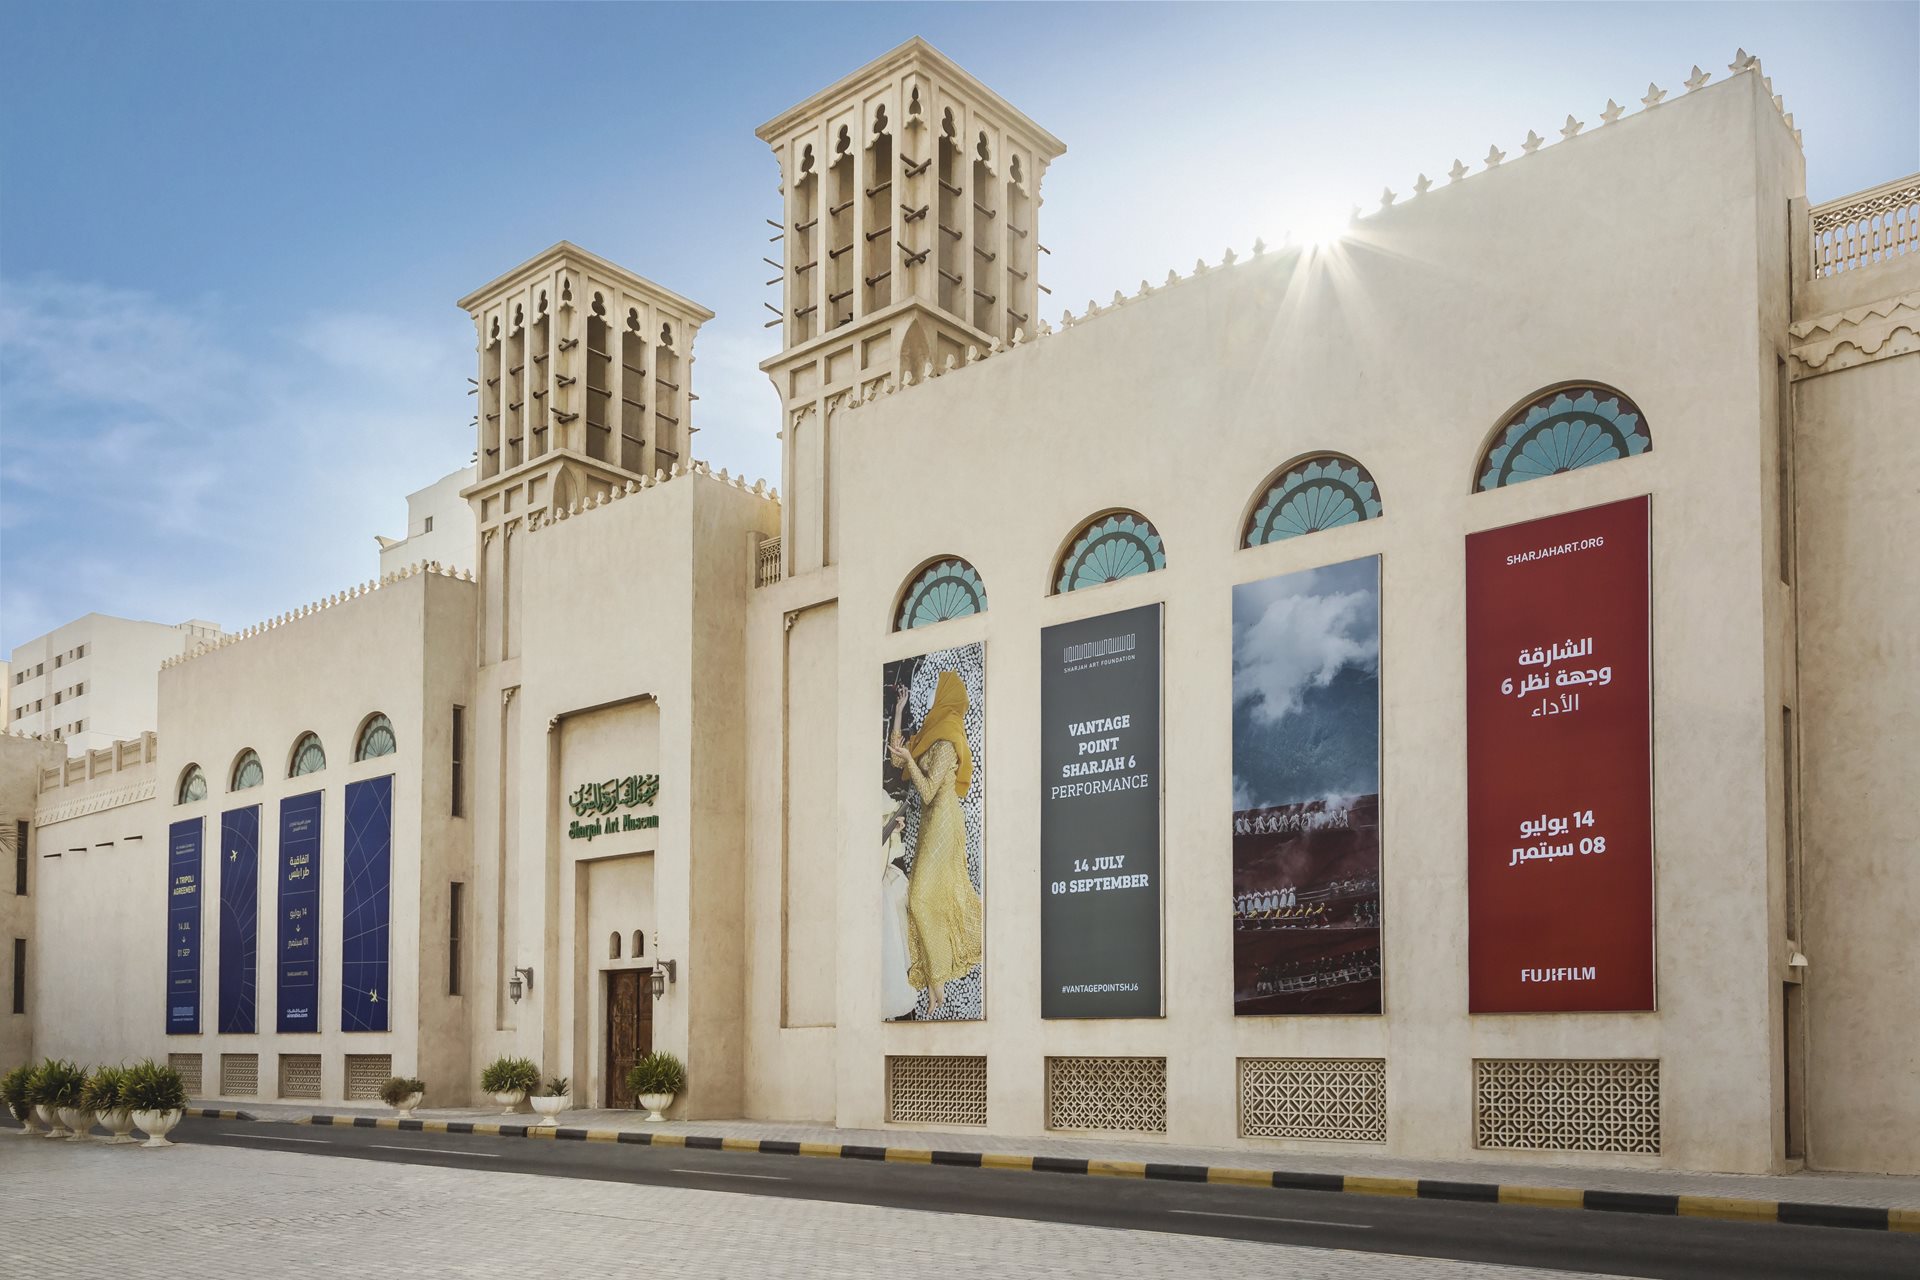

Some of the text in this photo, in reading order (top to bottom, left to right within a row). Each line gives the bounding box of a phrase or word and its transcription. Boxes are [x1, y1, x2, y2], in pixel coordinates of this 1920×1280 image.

[1506, 536, 1604, 566] SHARJAHART.ORG
[1518, 637, 1593, 667] الشارقة
[1064, 655, 1136, 674] SHARJAH ART FOUNDATION
[1501, 666, 1612, 698] وجهة نظر 6
[1531, 693, 1580, 717] الأداء
[1068, 714, 1131, 737] VANTAGE
[1078, 737, 1120, 755] POINT
[1062, 755, 1136, 778] SHARJAH 6
[1051, 774, 1148, 800] PERFORMANCE
[569, 814, 659, 842] Sharjah Art Museum
[1520, 810, 1595, 839] 14 يوليو
[1509, 836, 1606, 867] 08 سبتمبر
[1074, 855, 1125, 873] 14 JULY
[173, 885, 196, 896] AGREEMENT
[1051, 874, 1149, 895] 08 SEPTEMBER
[1521, 966, 1596, 982] FUJIFILM
[1061, 983, 1139, 994] #VANTAGEPOINTSHJ6
